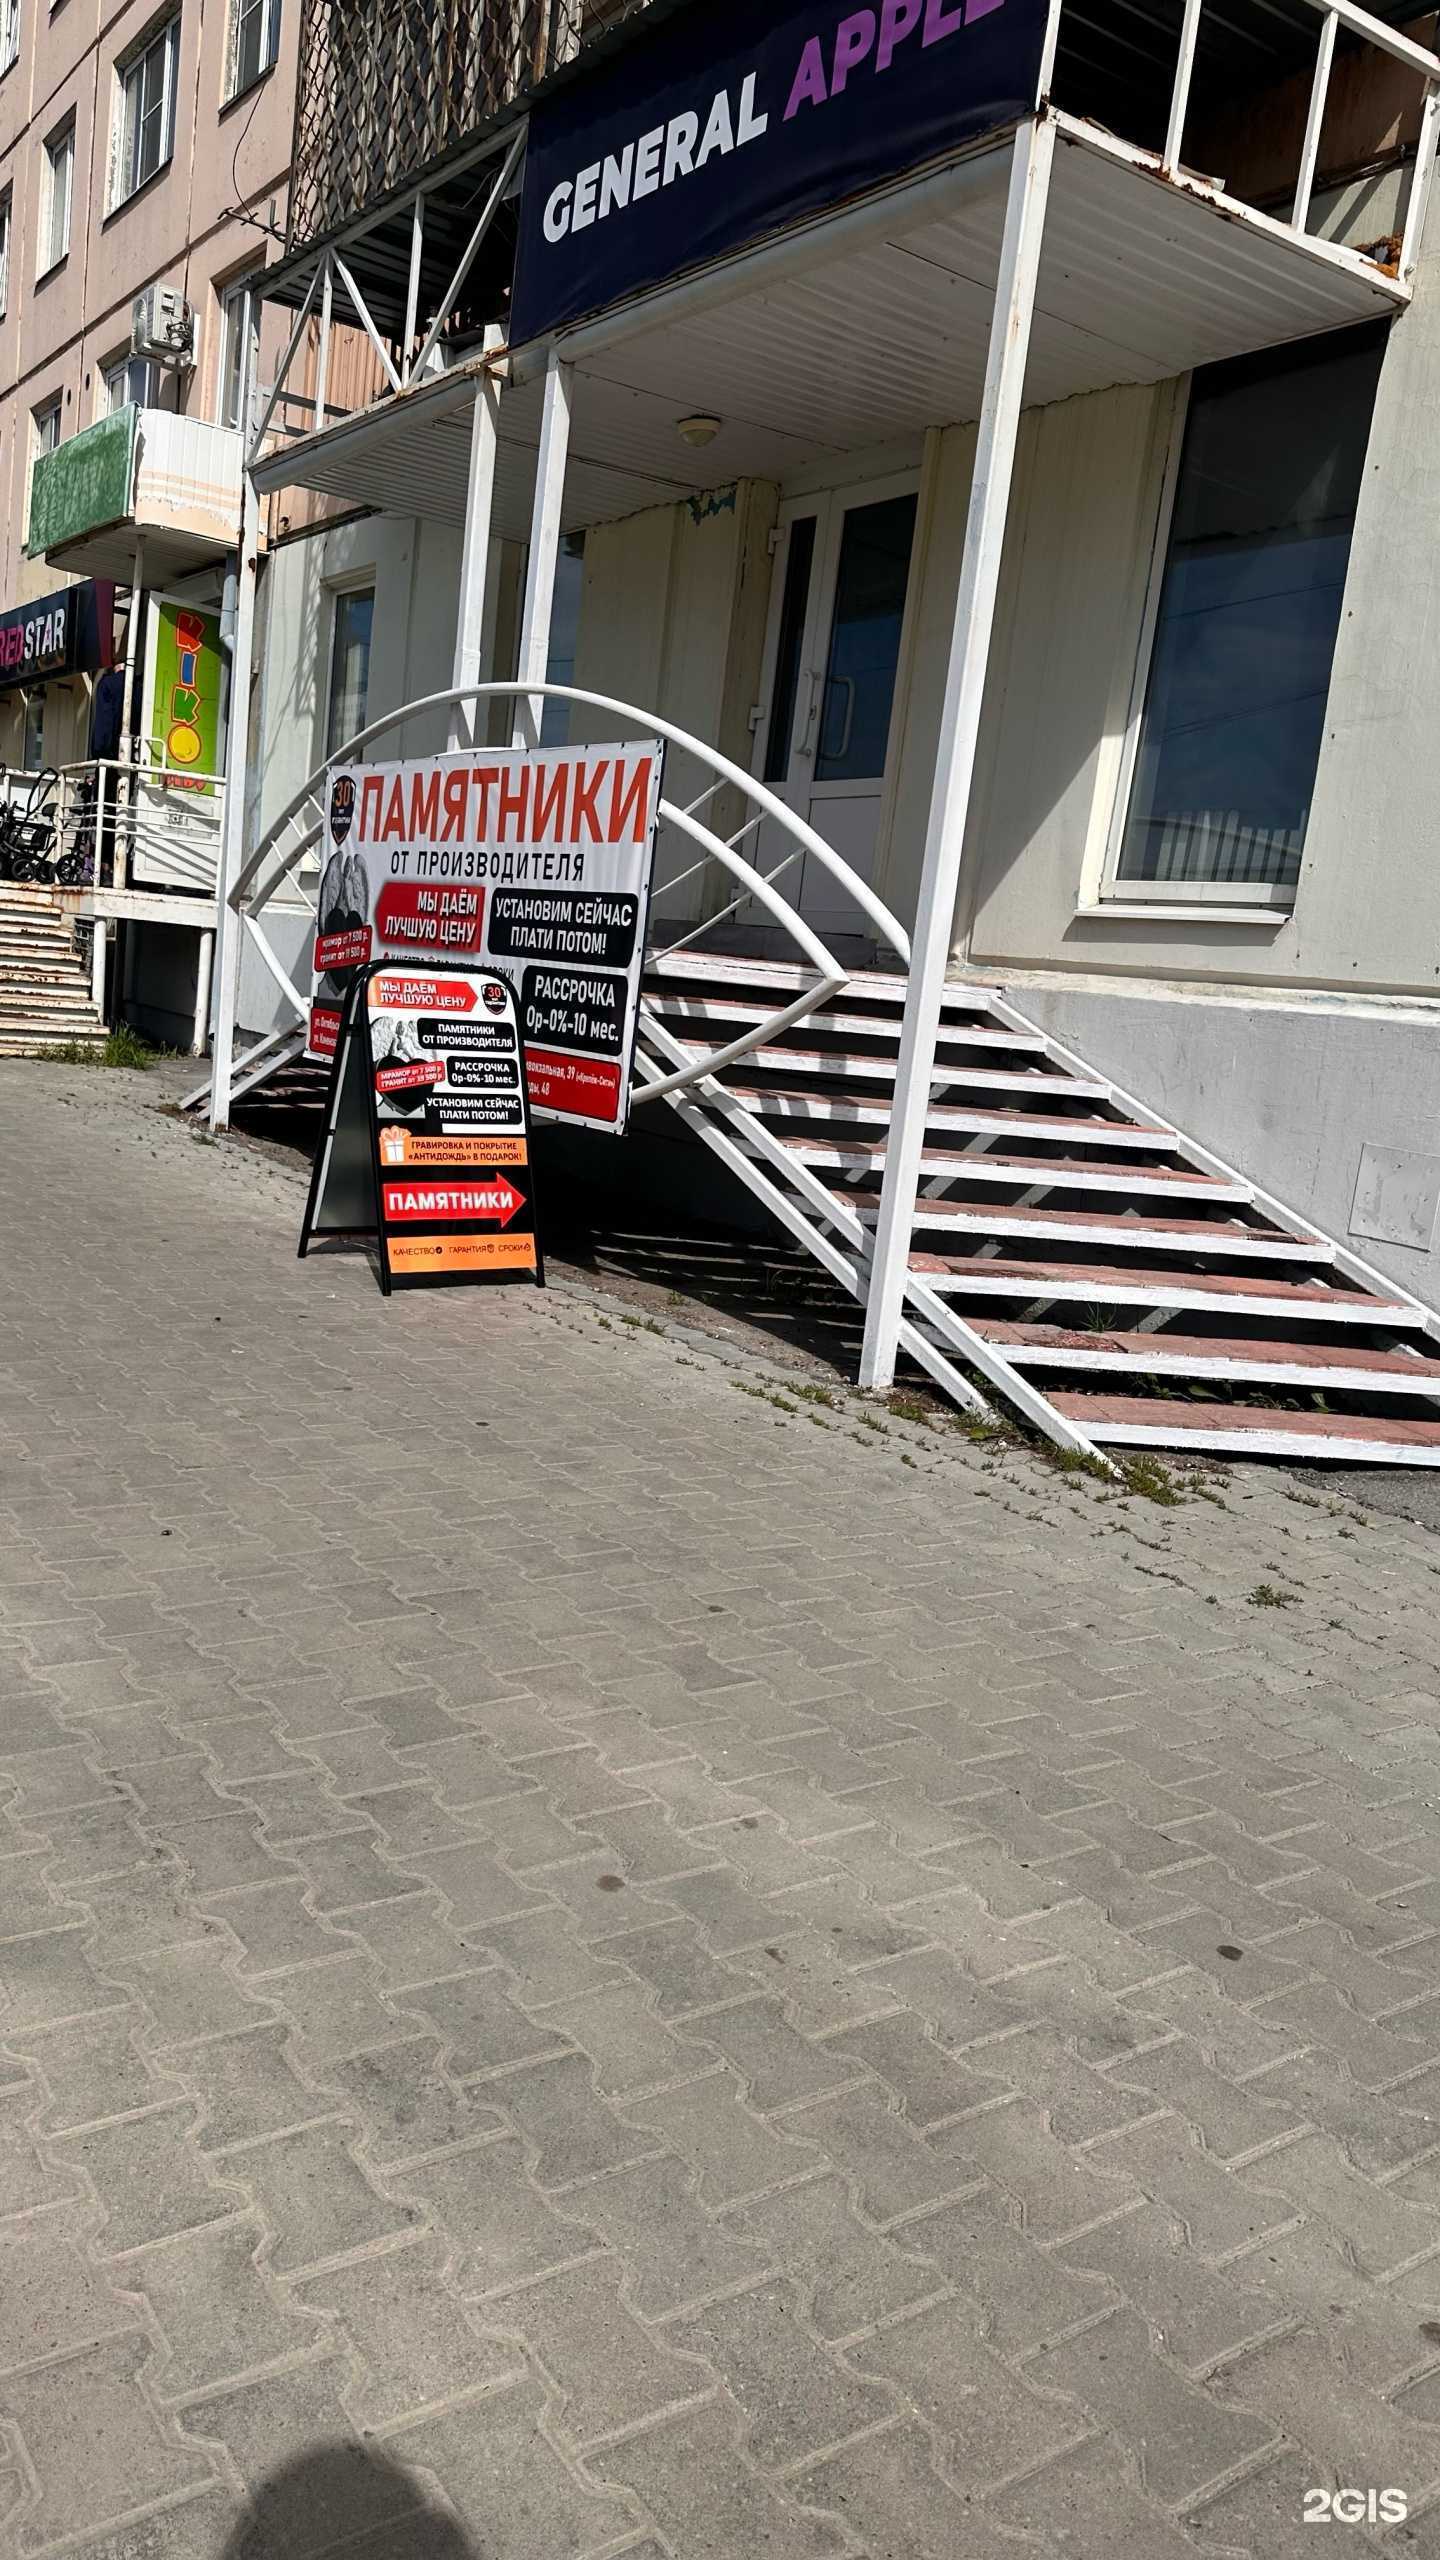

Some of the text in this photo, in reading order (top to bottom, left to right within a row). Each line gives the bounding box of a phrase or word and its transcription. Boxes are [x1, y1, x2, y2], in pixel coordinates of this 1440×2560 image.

[542, 71, 768, 243] GENERAL
[335, 781, 351, 807] 30
[358, 757, 653, 843] ПАМЯТНИКИ
[390, 851, 585, 883] ОТ ПРОИЗВОДИТЕЛЯ
[417, 888, 478, 916] МЫ ДАЁМ
[495, 897, 633, 927] УСТАНОВИМ СЕЙЧАС
[384, 916, 476, 945] ЛУЧШУЮ ЦЕНУ
[510, 926, 607, 955] ПЛАТИ ПОТОМ!
[379, 981, 401, 992] МЫ
[487, 986, 502, 998] 30
[534, 975, 616, 1007] РАССРОЧКА
[380, 993, 466, 1008] ЛУЧШУЮ ЦЕНУ
[438, 1024, 495, 1035] ПАМЯТНИКИ
[590, 1020, 619, 1041] мес.
[422, 1035, 513, 1047] ОТ ПРОИЗВОДИТЕЛЯ
[454, 1062, 510, 1072] РАССРОЧКА
[566, 1065, 576, 1080] 39
[495, 1076, 516, 1084] мес.
[541, 1081, 550, 1096] 48
[426, 1097, 519, 1109] УСТАНОВИМ СЕЙЧАС
[439, 1110, 509, 1121] ПЛАТИ ПОТОМ!
[411, 1141, 517, 1150] ГРАВИРОВКА И ПОКРЫТИЕ
[408, 1152, 471, 1161] «АНТИДОЖДЬ»
[480, 1153, 522, 1161] ПОДАРОК!
[388, 1192, 513, 1211] ПАМЯТНИКИ
[393, 1244, 523, 1256] КАЧЕСТВО ГАРАНТИЯ СРОКИ
